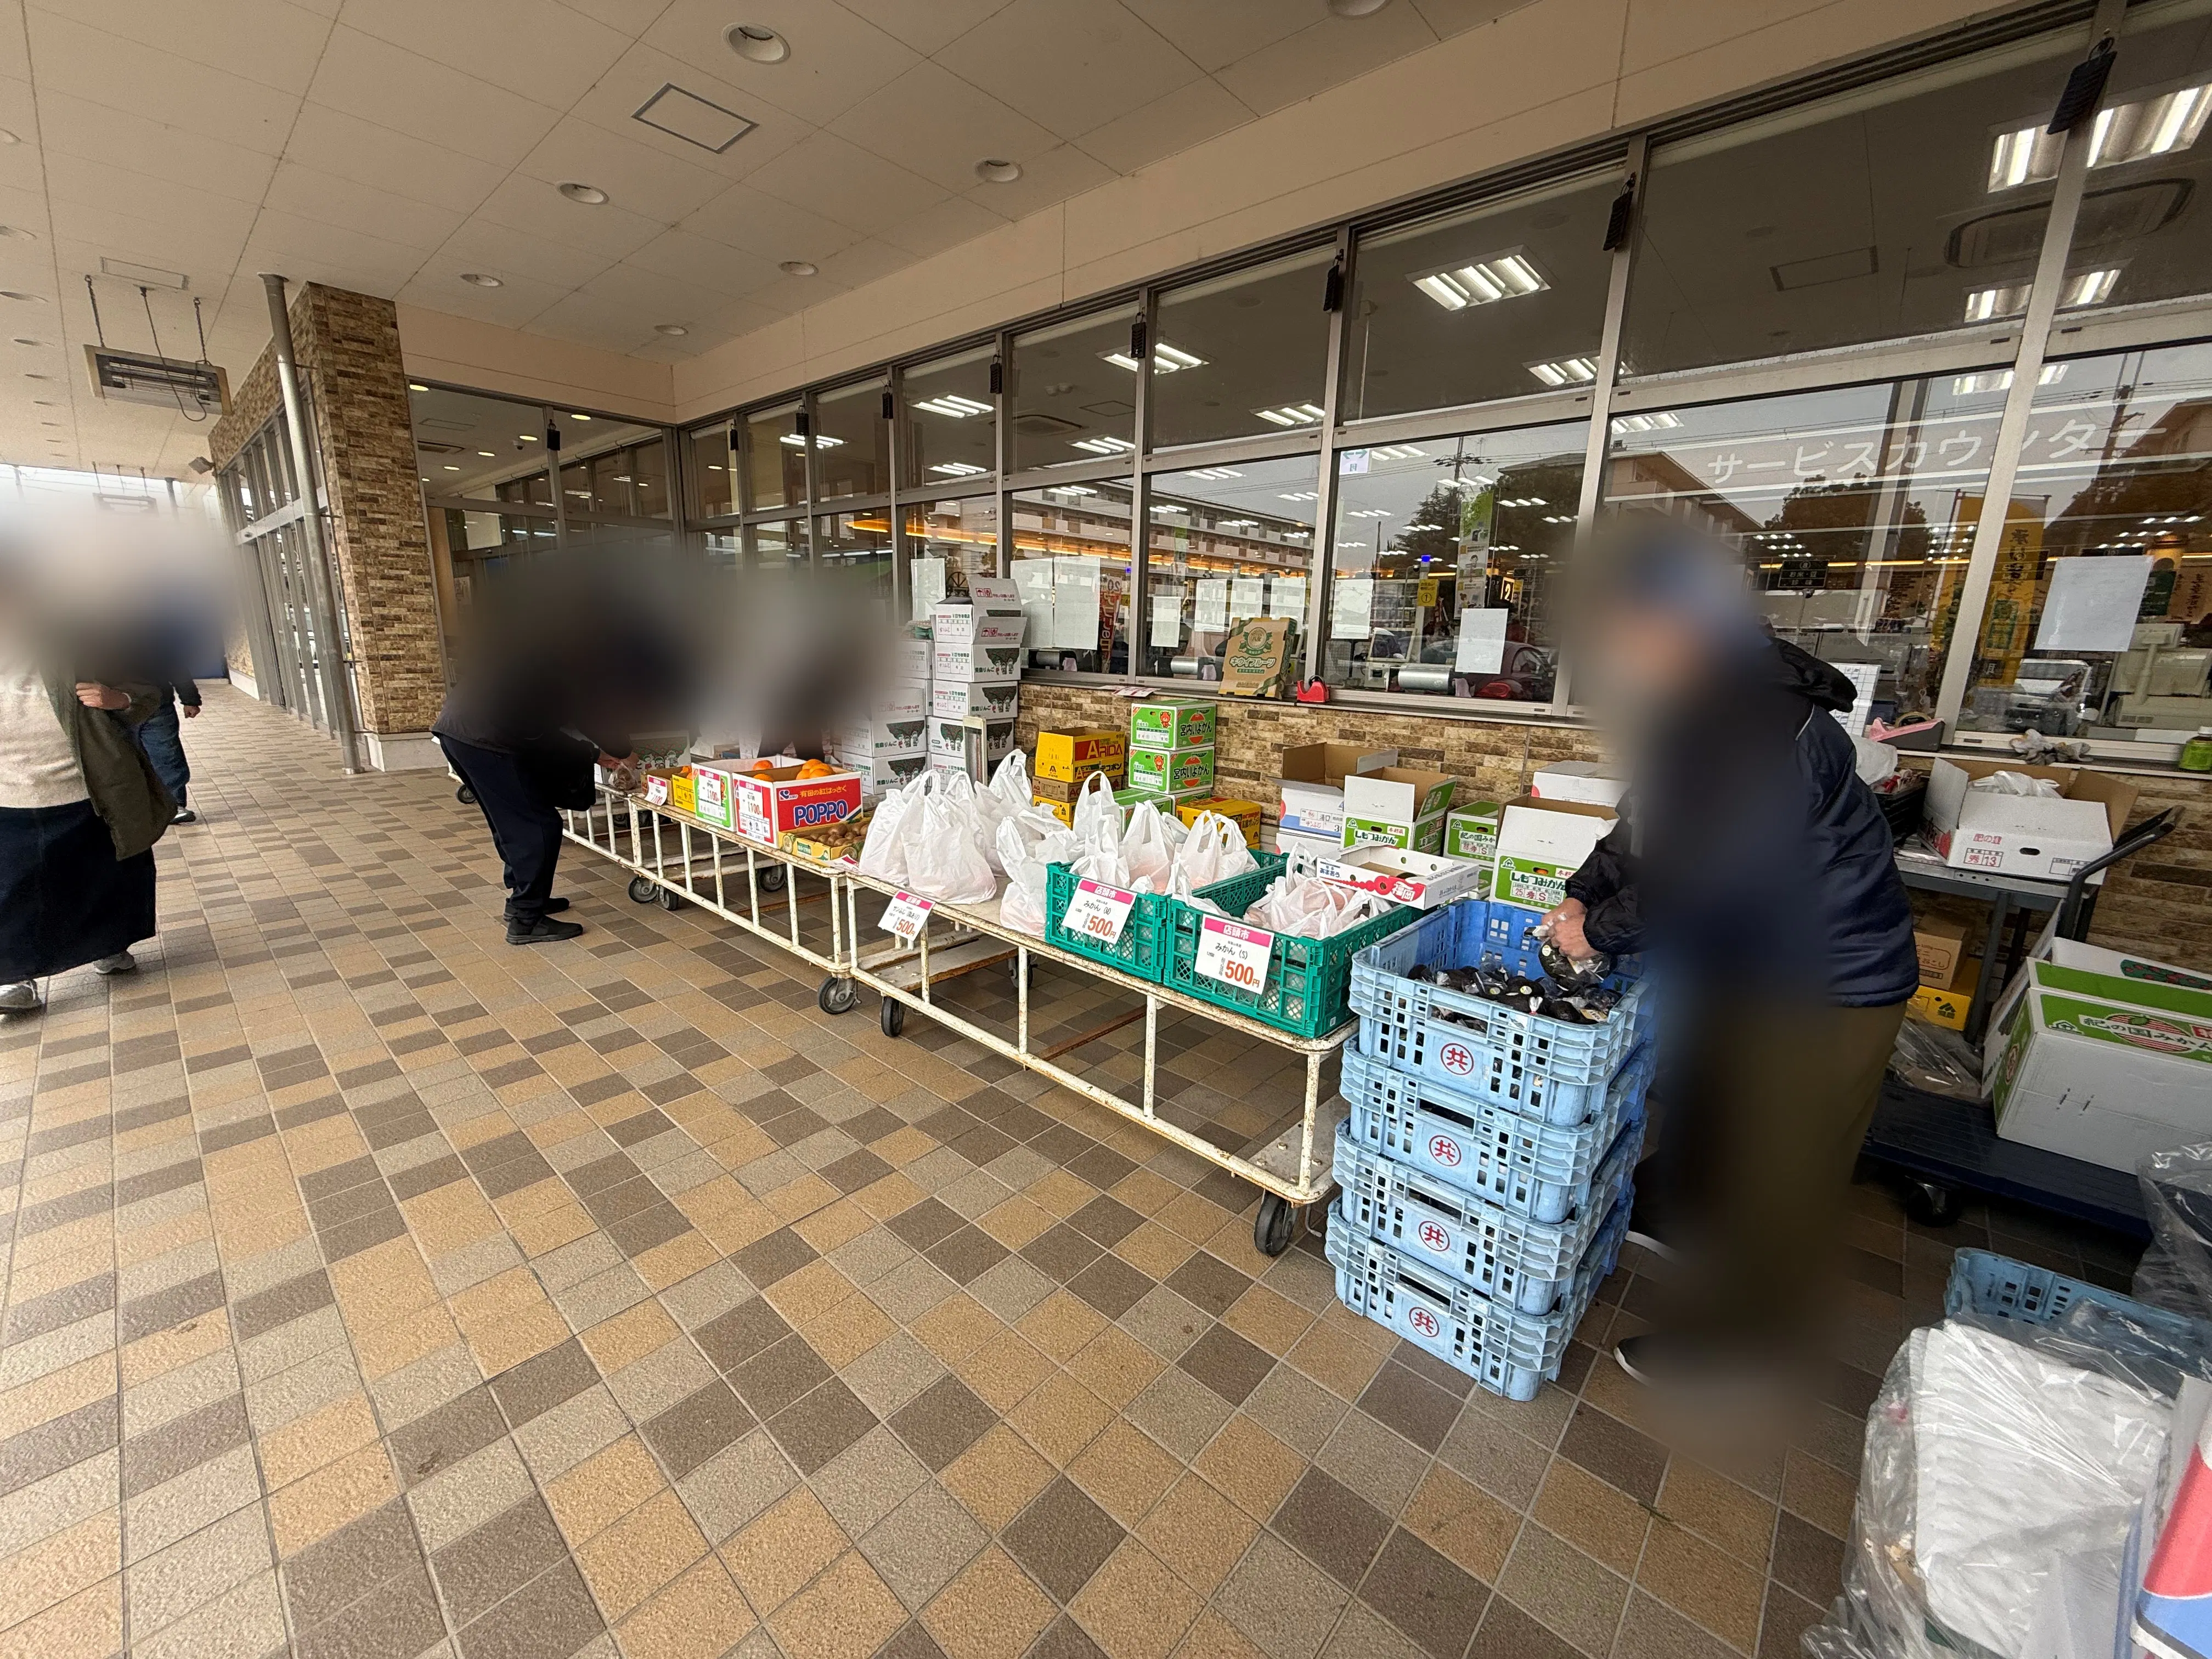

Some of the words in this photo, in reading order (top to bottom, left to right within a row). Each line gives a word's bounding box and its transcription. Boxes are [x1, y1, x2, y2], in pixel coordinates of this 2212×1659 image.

[1229, 658, 1276, 668] キウイフルーツ
[1180, 721, 1212, 736] 宮内いよかん
[1087, 741, 1122, 759] ARIDA
[1173, 765, 1209, 780] 宮内いよかん
[799, 784, 847, 798] 有田の紅はっさく
[794, 800, 848, 827] POPPO
[1355, 830, 1397, 845] しもつみかん
[1319, 867, 1340, 878] あまおう
[1511, 872, 1566, 891] しもつみかん
[1392, 881, 1416, 901] 福岡
[1539, 893, 1547, 901] S
[1084, 900, 1101, 912] みかん
[1223, 924, 1251, 940] 店頭市
[1215, 943, 1235, 956] みかん
[1225, 960, 1260, 988] 500円
[1446, 1047, 1468, 1071] 共
[1435, 1139, 1455, 1164] 共
[1424, 1225, 1444, 1248] 共
[1414, 1311, 1434, 1335] 共
